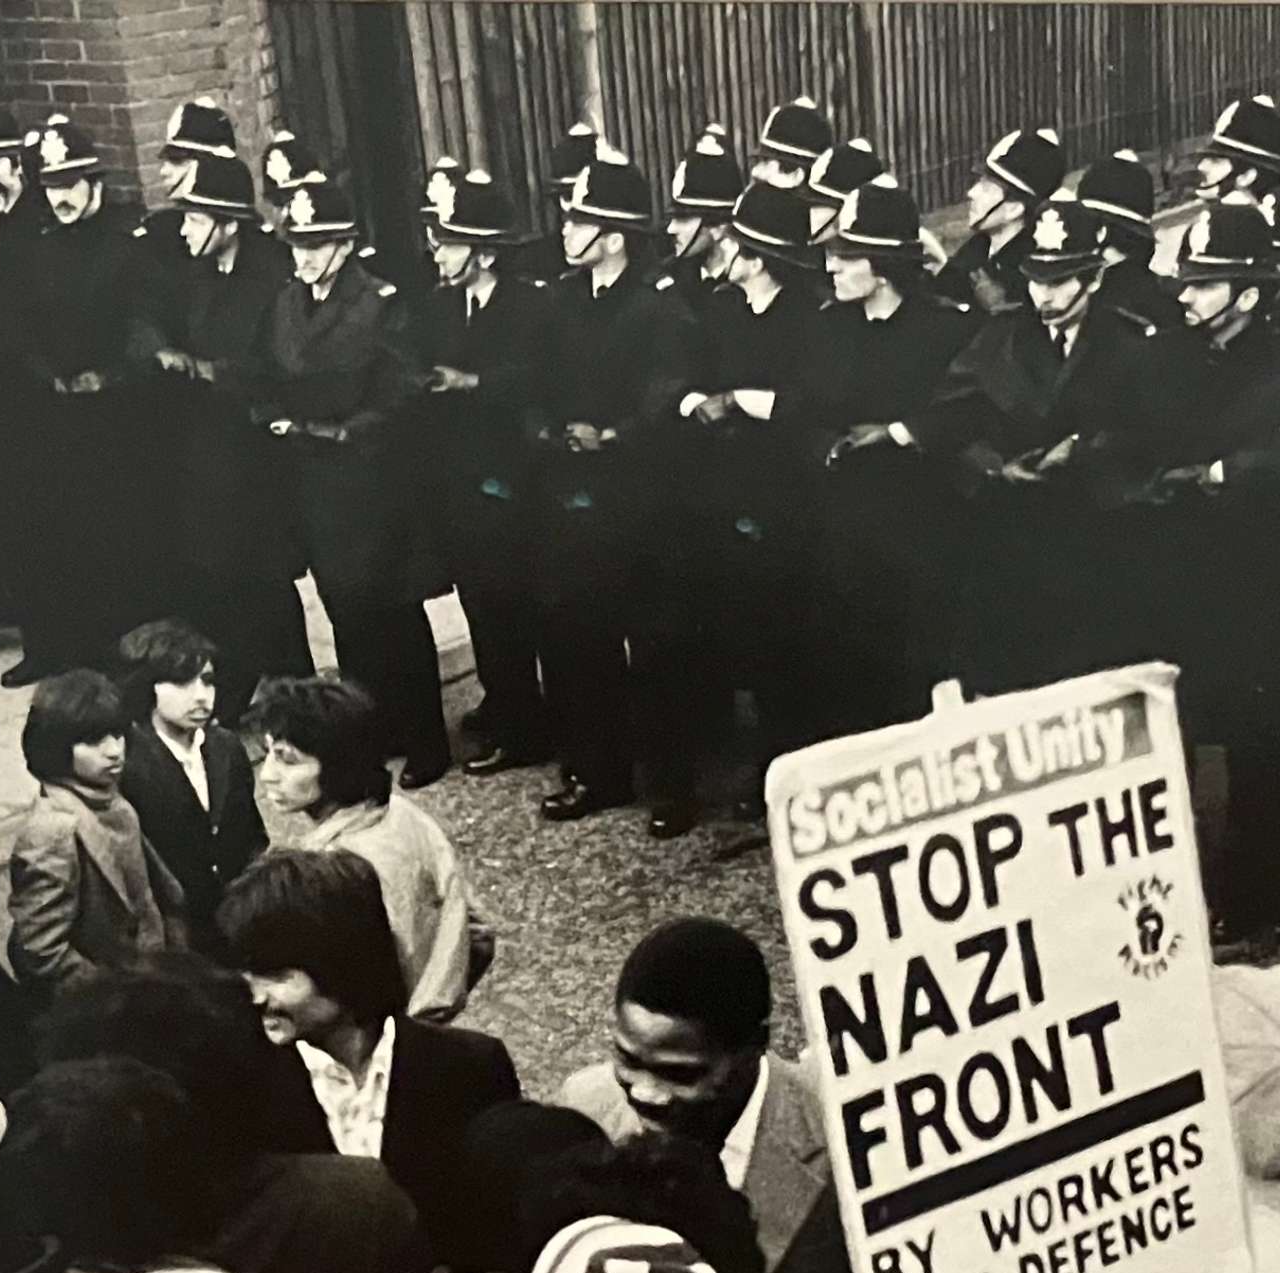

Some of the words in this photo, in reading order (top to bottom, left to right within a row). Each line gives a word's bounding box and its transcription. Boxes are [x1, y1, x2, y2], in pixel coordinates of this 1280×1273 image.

[789, 735, 1004, 854] Socialist
[1005, 706, 1125, 782] Unity
[798, 813, 1023, 961] STOP
[1048, 778, 1174, 877] THE
[819, 918, 1045, 1077] NAZI
[841, 1000, 1121, 1191] FRONT
[980, 1123, 1204, 1252] WORKERS
